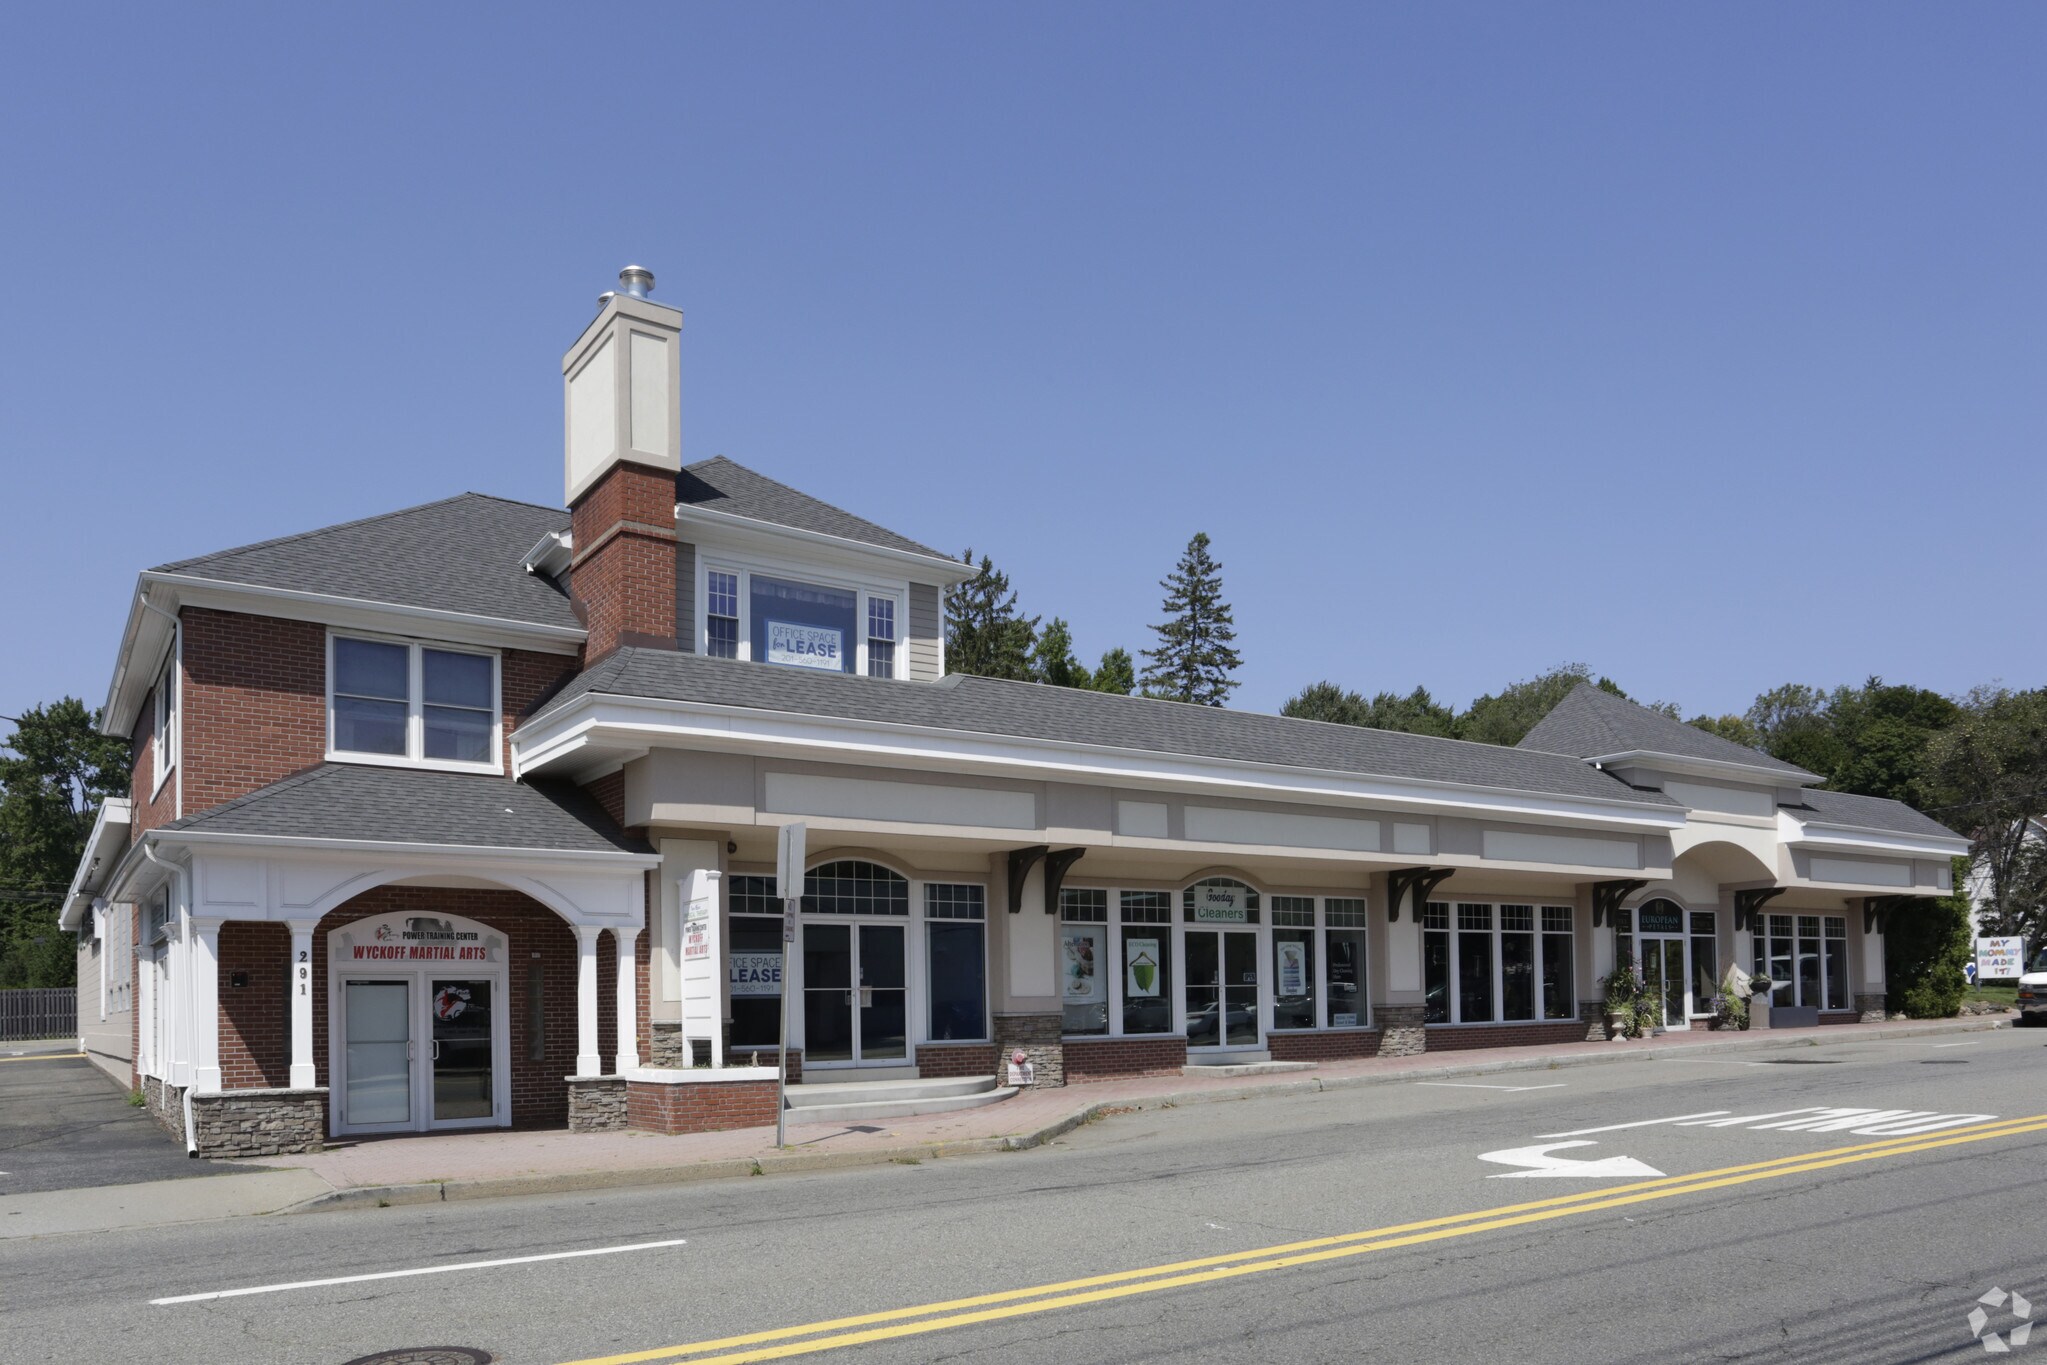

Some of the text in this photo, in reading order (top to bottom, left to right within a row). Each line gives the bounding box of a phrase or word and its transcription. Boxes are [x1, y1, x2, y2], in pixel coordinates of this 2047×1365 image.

[772, 625, 837, 645] OFFICE SPACE
[772, 637, 837, 658] for LEASE
[782, 654, 830, 667] 201-560-1191
[1198, 907, 1244, 919] Cleaners
[1641, 915, 1678, 924] EUROPEAN
[402, 931, 425, 940] POWER
[426, 931, 454, 941] TRAINING
[455, 932, 479, 941] CENTER
[1990, 939, 2010, 947] MY
[353, 945, 486, 961] WYCKOFF MARTIAL ARTS
[1978, 948, 2021, 957] MOMMY
[750, 957, 782, 968] SPACE
[1981, 958, 2015, 967] MADE
[730, 968, 781, 983] LEASE
